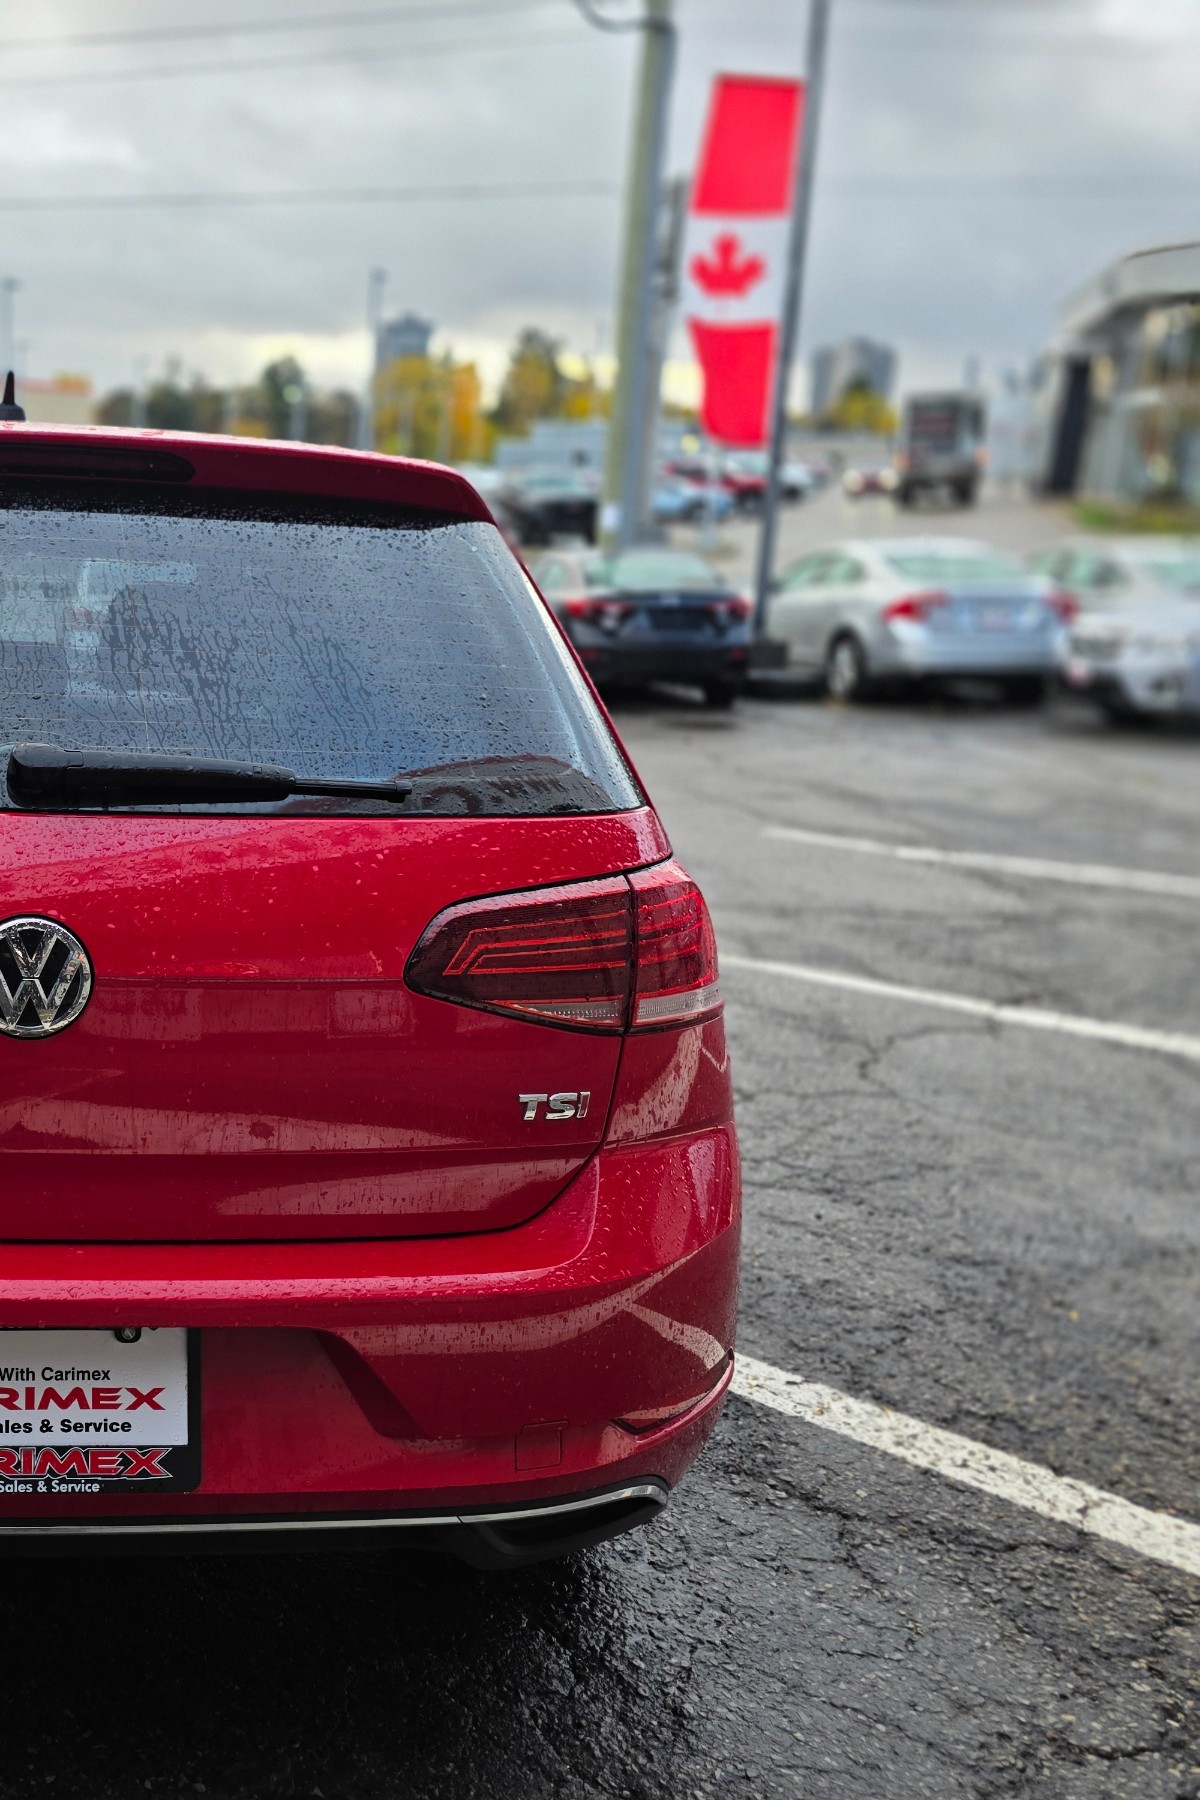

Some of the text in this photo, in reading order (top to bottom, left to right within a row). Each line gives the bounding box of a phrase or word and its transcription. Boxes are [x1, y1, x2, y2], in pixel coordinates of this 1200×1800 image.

[518, 1091, 590, 1120] TSI
[41, 1366, 111, 1382] Carimex
[39, 1418, 54, 1433] &
[60, 1418, 132, 1433] Service
[36, 1480, 48, 1493] &
[51, 1479, 101, 1493] Service
